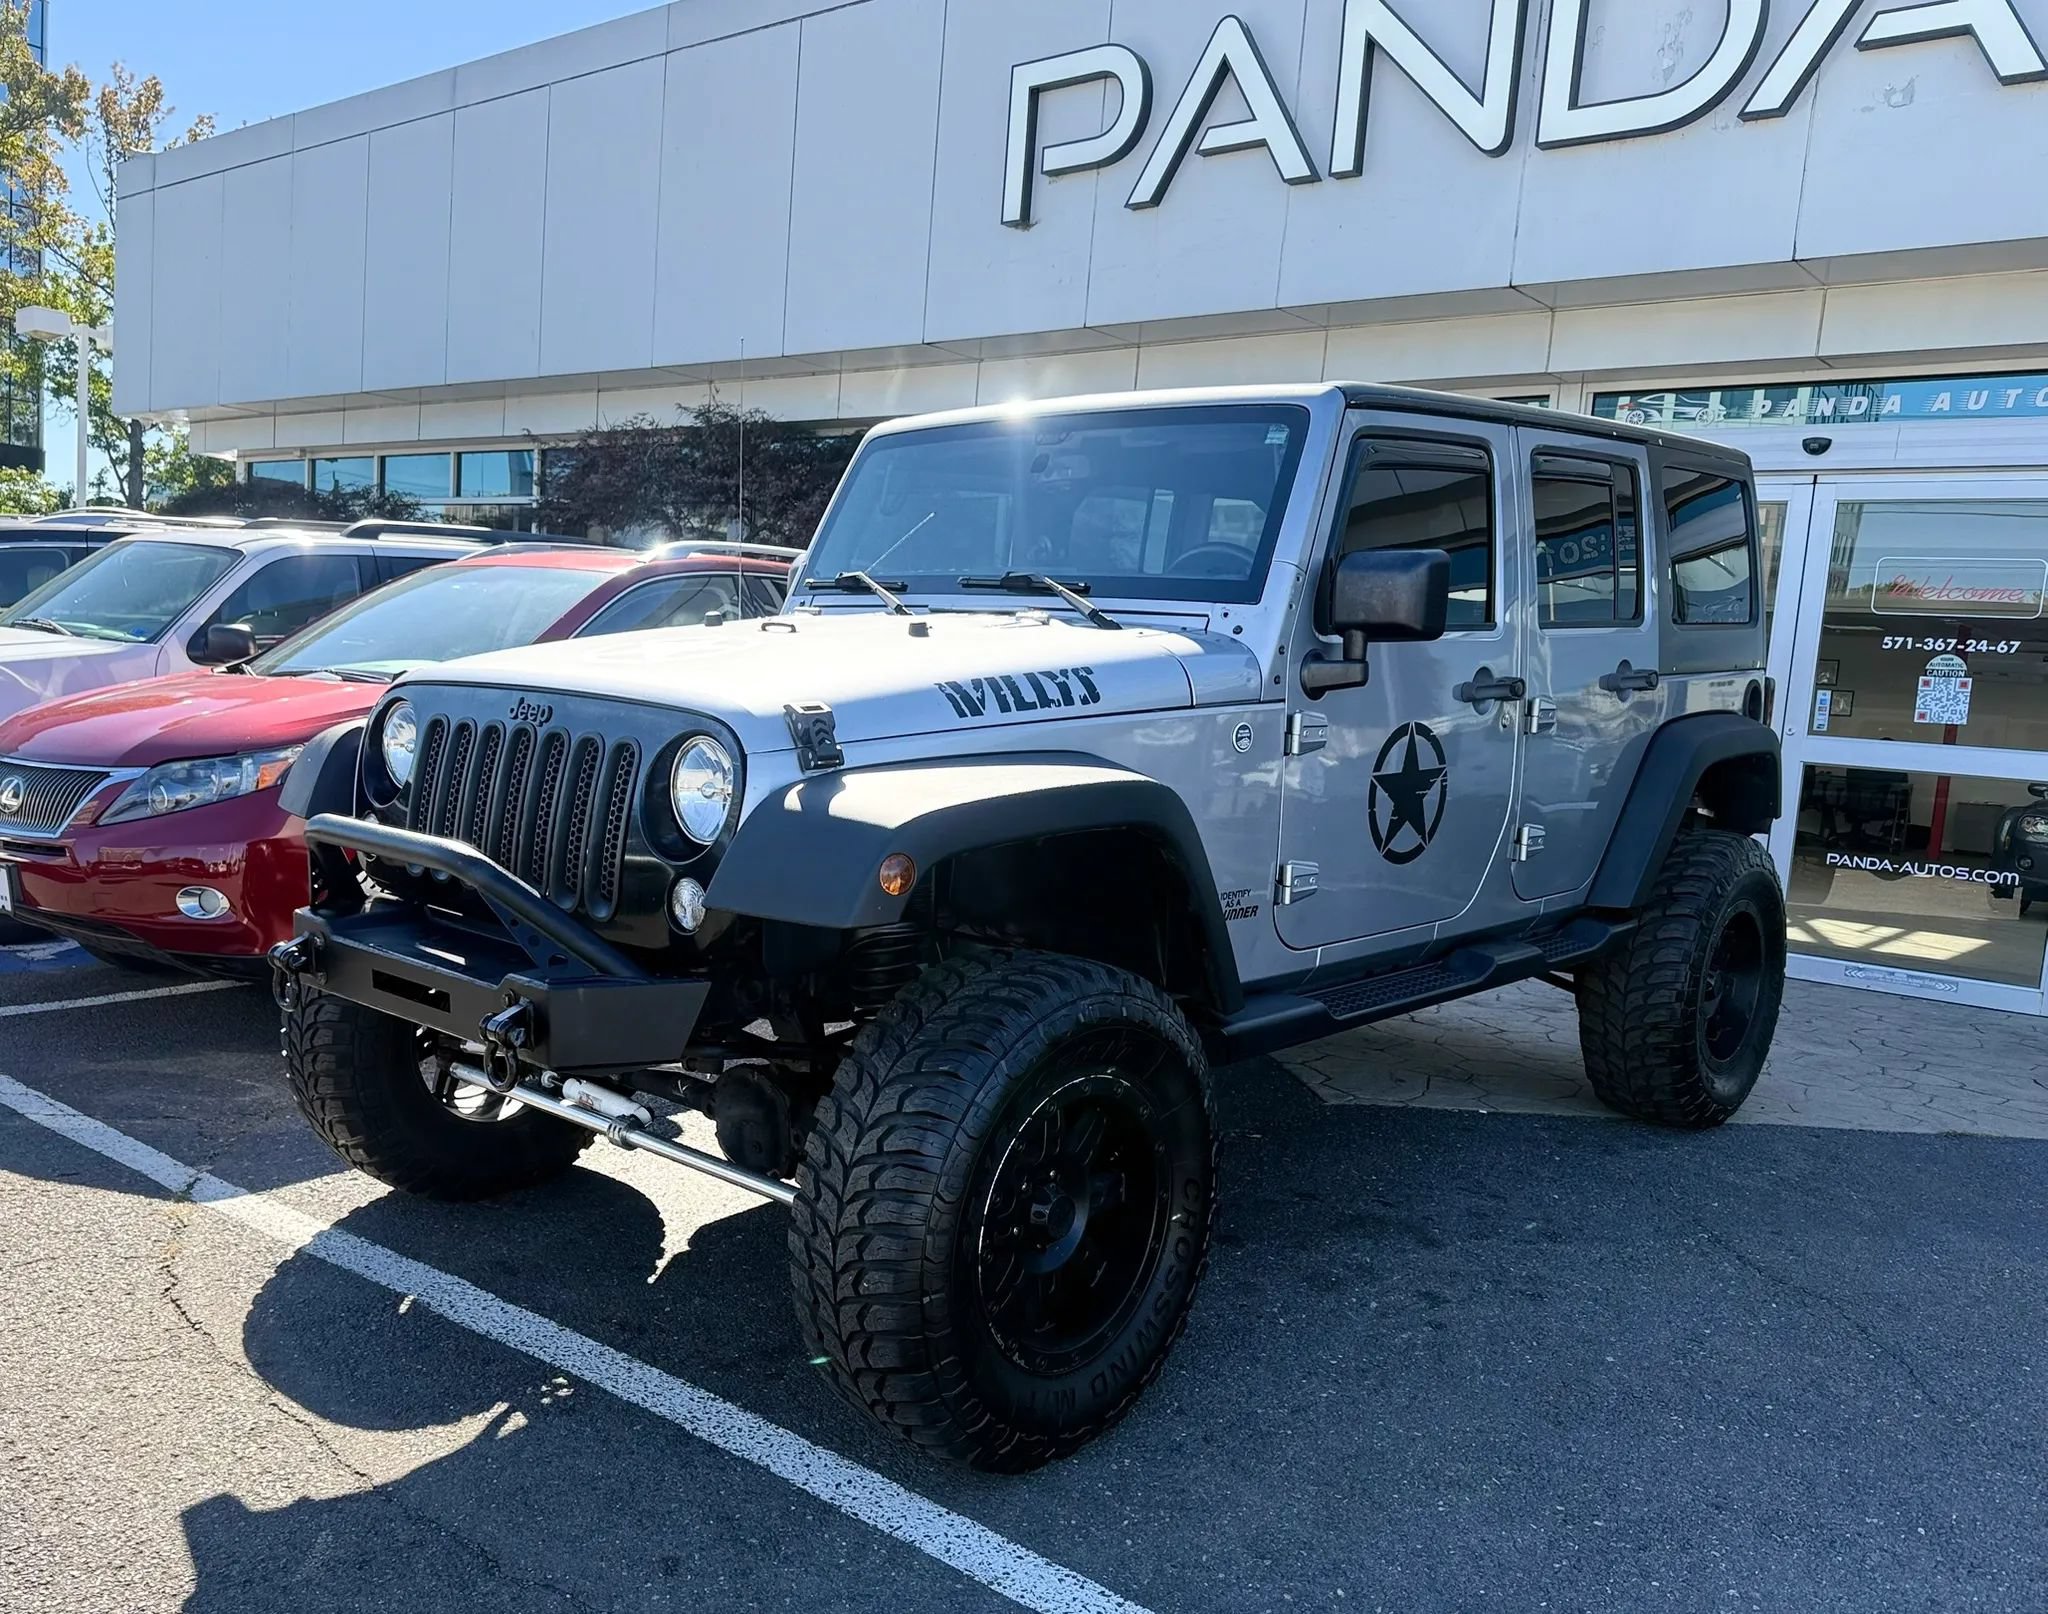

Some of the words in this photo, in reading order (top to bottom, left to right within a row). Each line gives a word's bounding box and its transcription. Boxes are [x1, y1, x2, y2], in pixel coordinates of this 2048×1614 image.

[1751, 394, 1901, 418] PANDA
[1888, 574, 2026, 601] Welcome
[1881, 636, 2021, 654] 571-367-24-67
[1926, 669, 1965, 678] CAUTION
[1929, 661, 1964, 669] AUTOMATIC
[934, 666, 1101, 719] WILLYS
[508, 696, 553, 727] Jeep
[1220, 888, 1252, 901] IDENTIFY
[1225, 899, 1234, 908] AS
[1223, 905, 1259, 921] UNNER
[1090, 1176, 1202, 1398] CROSSWIND
